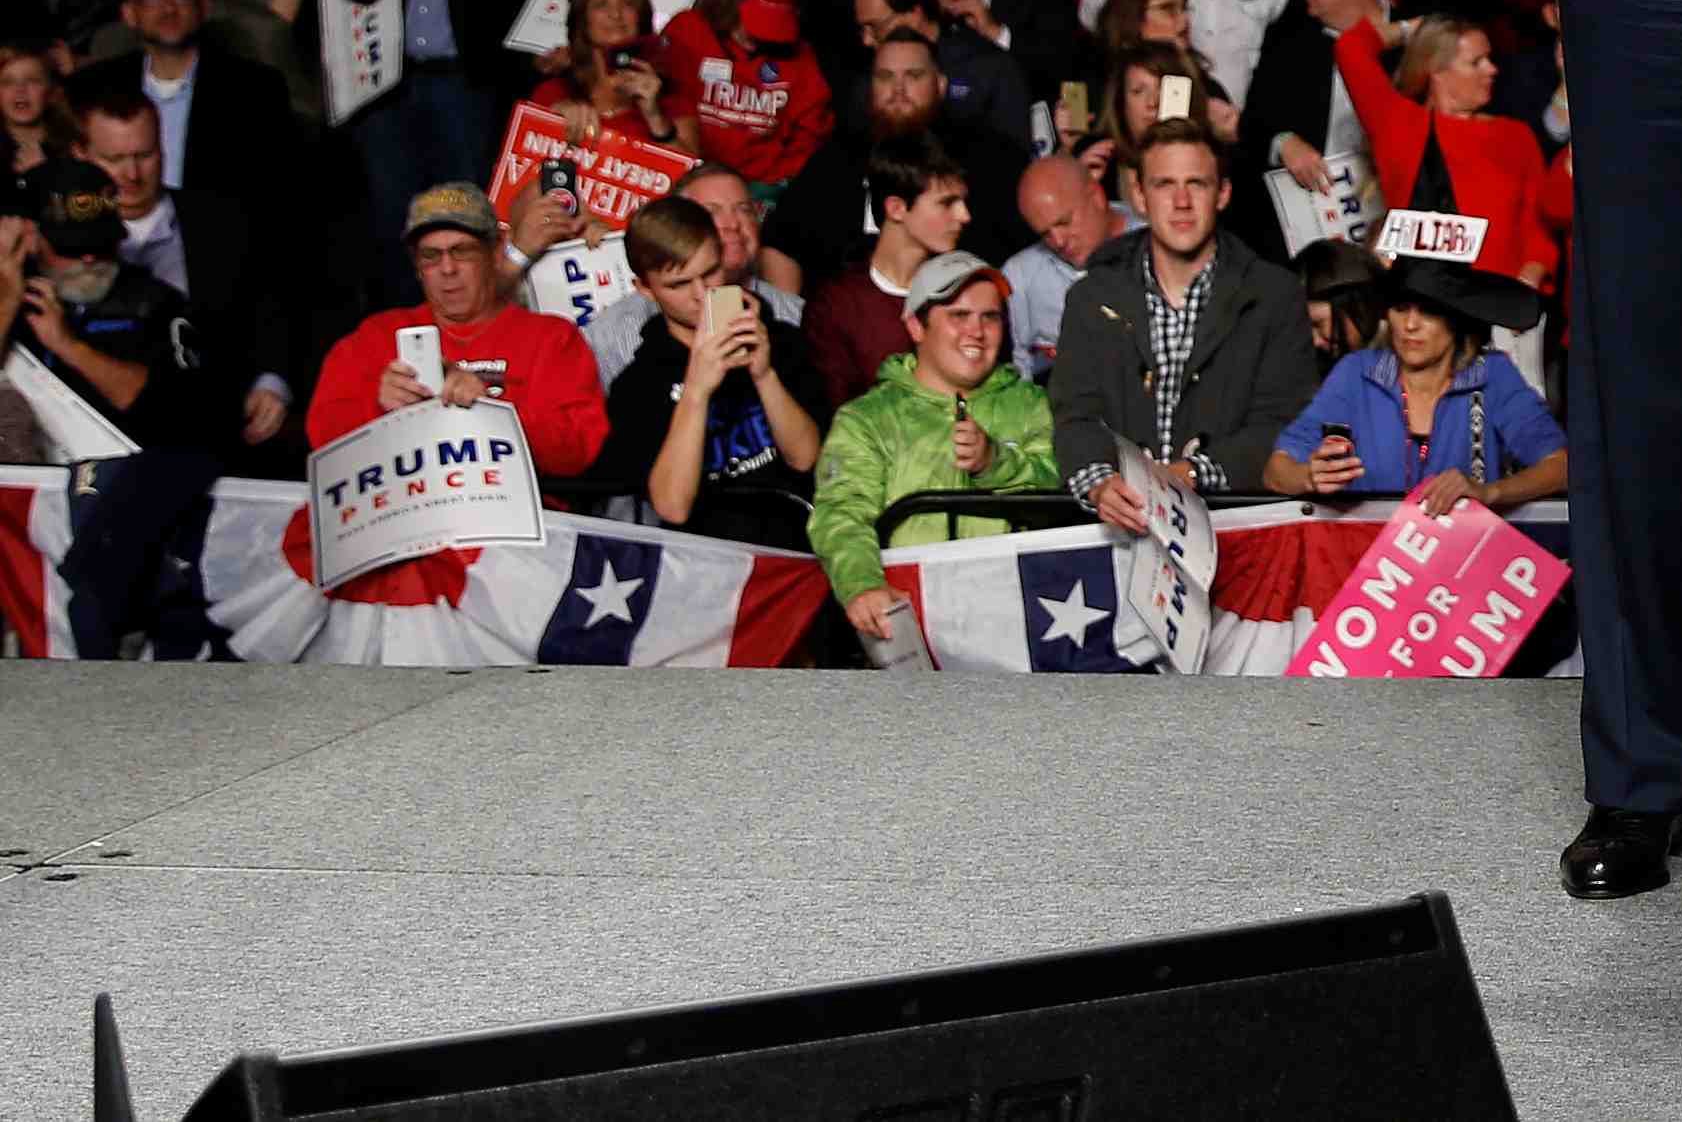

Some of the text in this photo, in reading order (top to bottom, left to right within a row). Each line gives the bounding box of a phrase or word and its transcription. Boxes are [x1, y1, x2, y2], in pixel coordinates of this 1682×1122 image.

[702, 80, 789, 118] TRUMP
[597, 155, 672, 195] GREAT
[1332, 166, 1370, 246] TRU
[325, 437, 515, 509] TRUMP
[340, 469, 506, 524] PENCE
[1388, 582, 1461, 669] FOR
[1440, 553, 1541, 677] UMP
